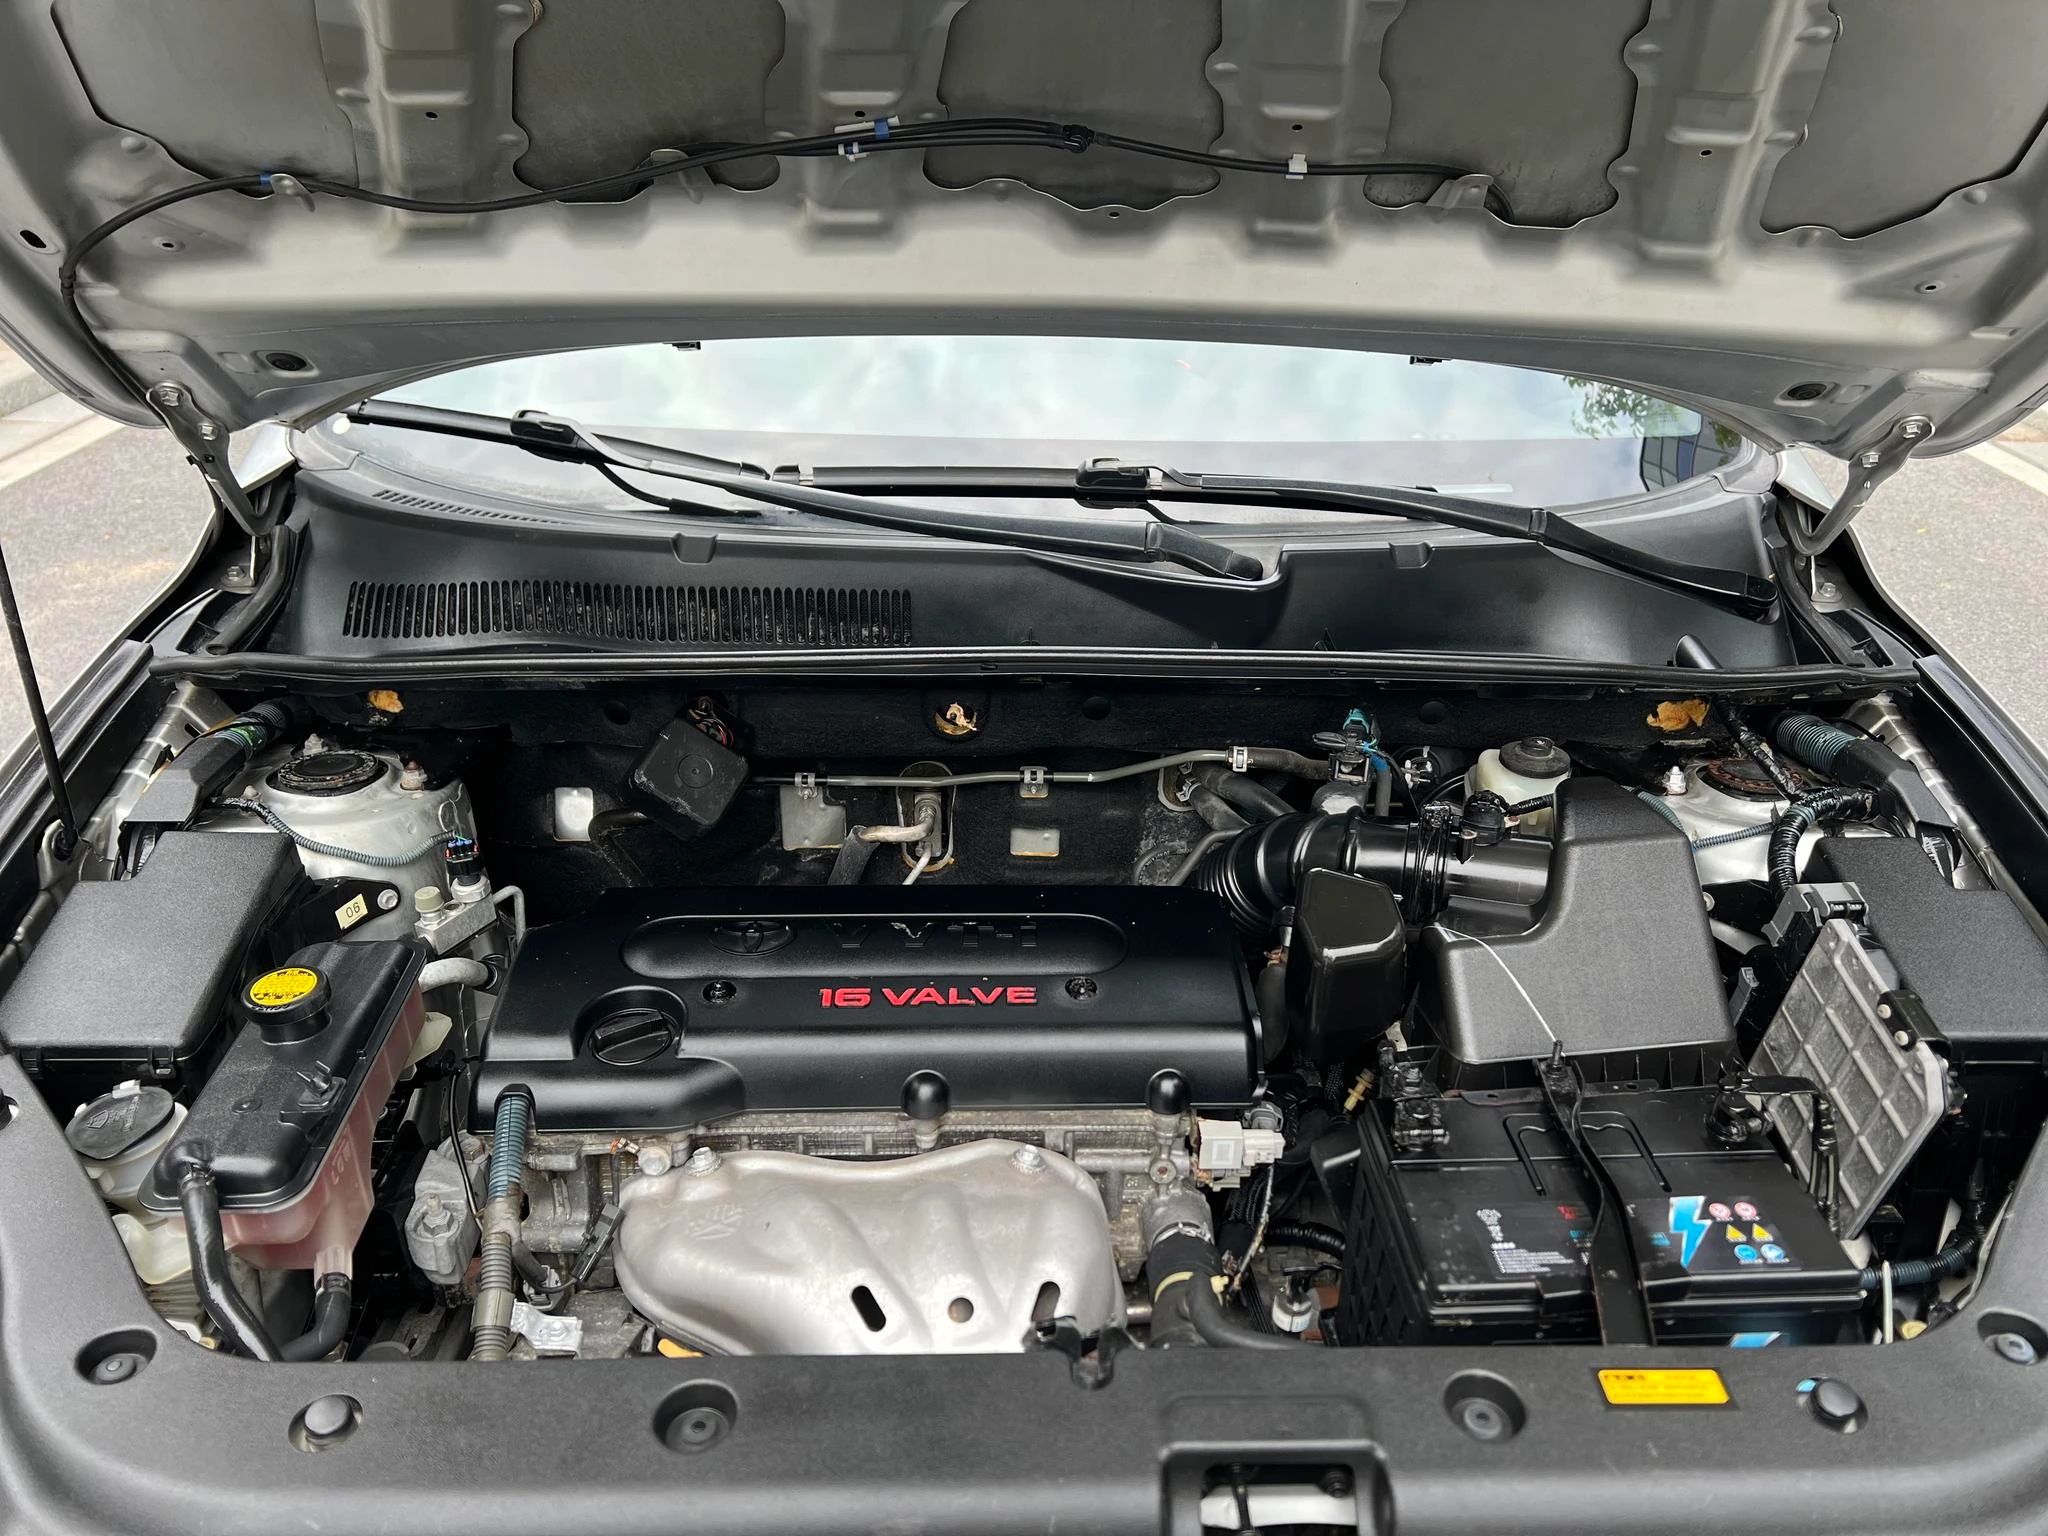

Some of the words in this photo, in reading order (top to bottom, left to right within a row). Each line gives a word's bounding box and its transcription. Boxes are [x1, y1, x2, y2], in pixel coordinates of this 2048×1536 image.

[346, 902, 361, 918] 06
[819, 987, 872, 1007] 16
[881, 986, 1038, 1006] VALVE
